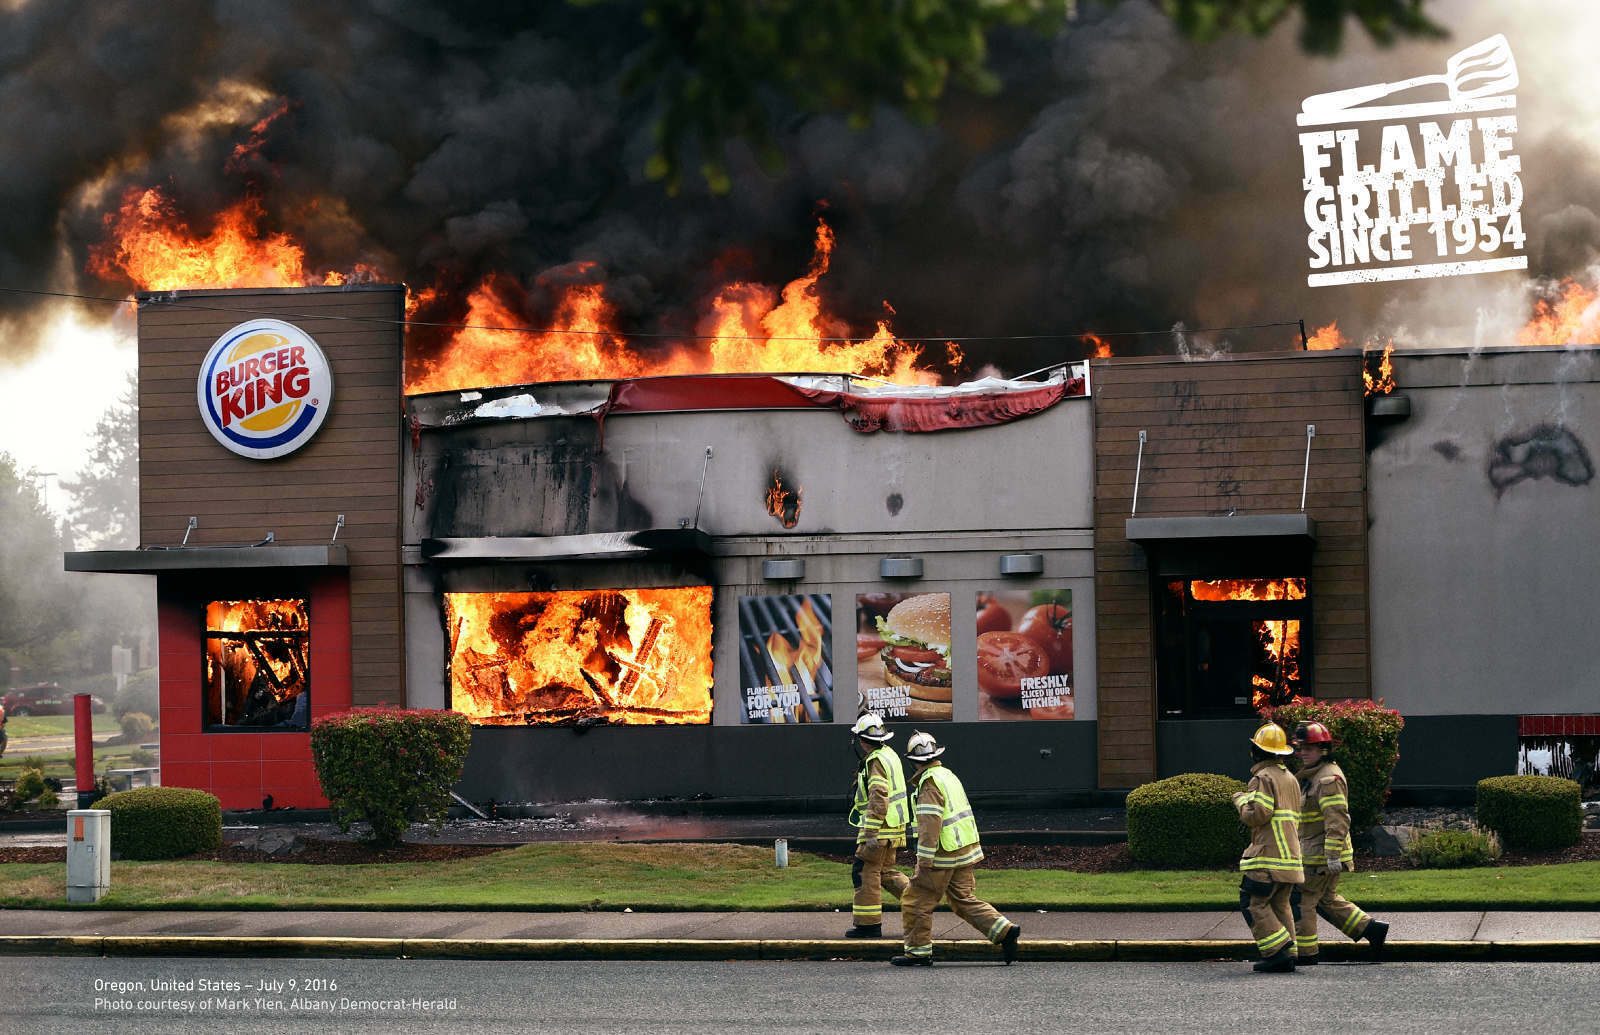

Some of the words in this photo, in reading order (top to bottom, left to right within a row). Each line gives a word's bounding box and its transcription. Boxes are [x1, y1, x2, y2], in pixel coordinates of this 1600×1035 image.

[216, 346, 306, 397] BURGER
[220, 366, 310, 428] KING
[1020, 675, 1068, 690] FRESHLY
[867, 685, 911, 700] FRESHLY
[1021, 690, 1044, 699] SLICED
[1045, 688, 1054, 697] IN
[1054, 687, 1070, 695] OUR
[747, 694, 772, 710] FOR
[868, 696, 912, 709] PREPARED
[1021, 696, 1064, 709] KITCHEN.
[748, 709, 769, 719] SINCE
[887, 706, 909, 717] YOU.
